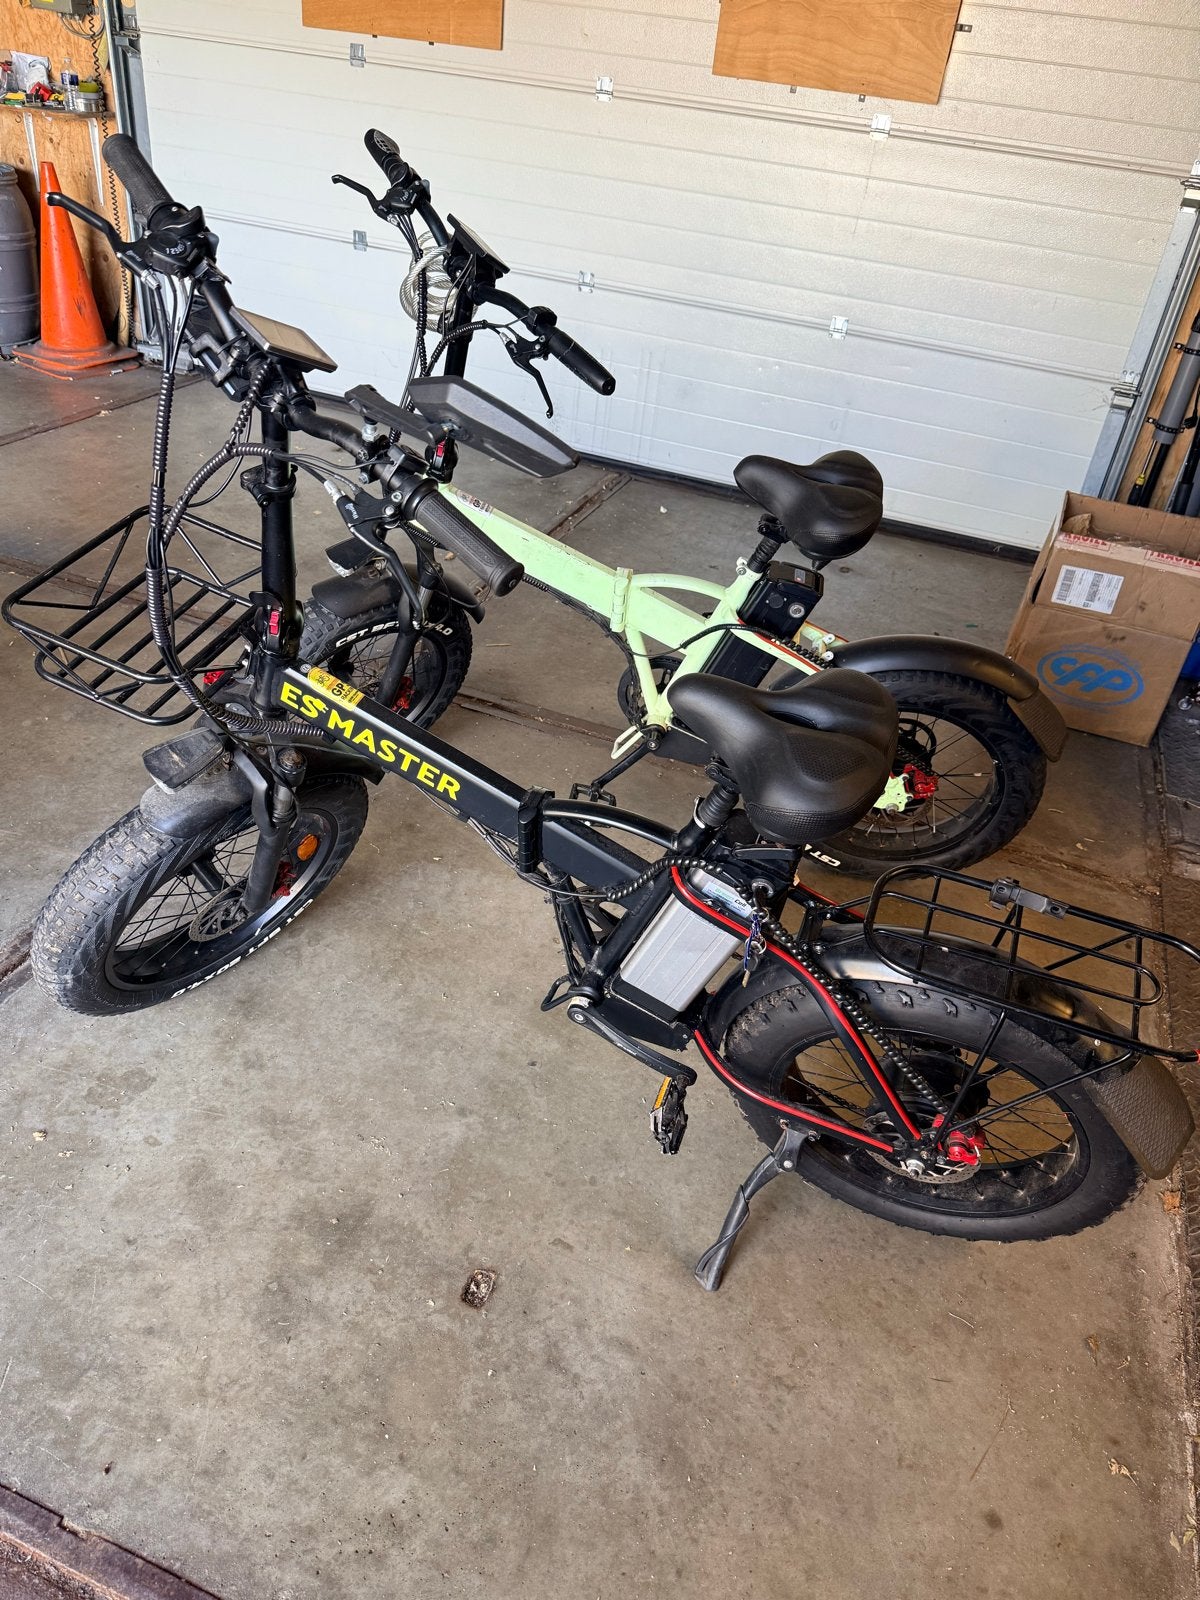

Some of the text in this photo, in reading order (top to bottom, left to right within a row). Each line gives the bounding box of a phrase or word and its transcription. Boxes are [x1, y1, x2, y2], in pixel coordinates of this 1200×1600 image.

[336, 628, 369, 648] CST
[331, 682, 346, 697] GP
[327, 709, 461, 801] MASTER
[809, 850, 841, 867] CST
